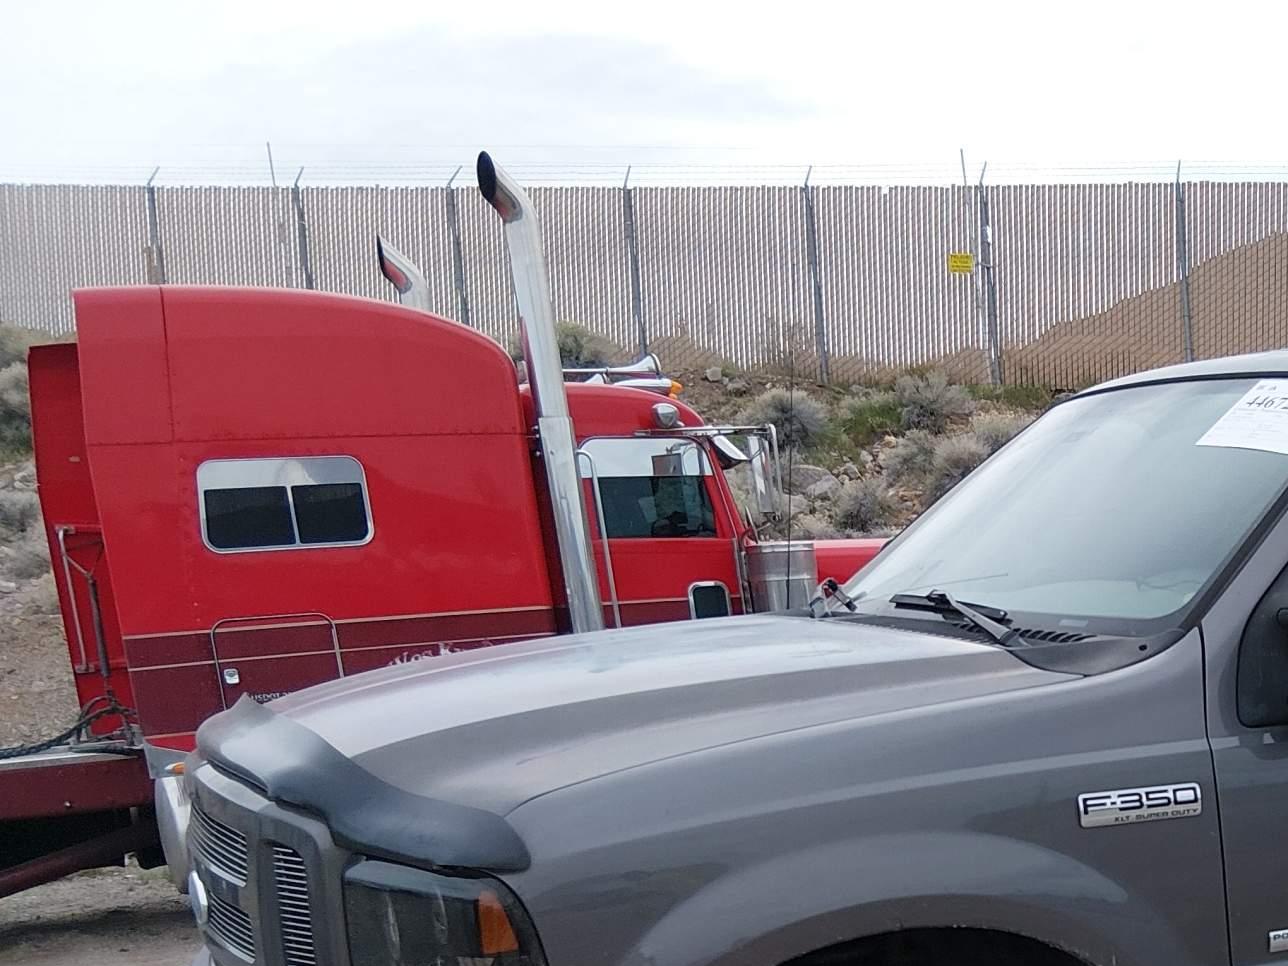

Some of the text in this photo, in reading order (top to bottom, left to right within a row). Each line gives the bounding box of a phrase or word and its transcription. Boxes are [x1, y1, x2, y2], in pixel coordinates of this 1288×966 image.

[1083, 787, 1199, 815] F-350
[1135, 811, 1169, 821] SUPER
[1171, 808, 1199, 817] DUTY
